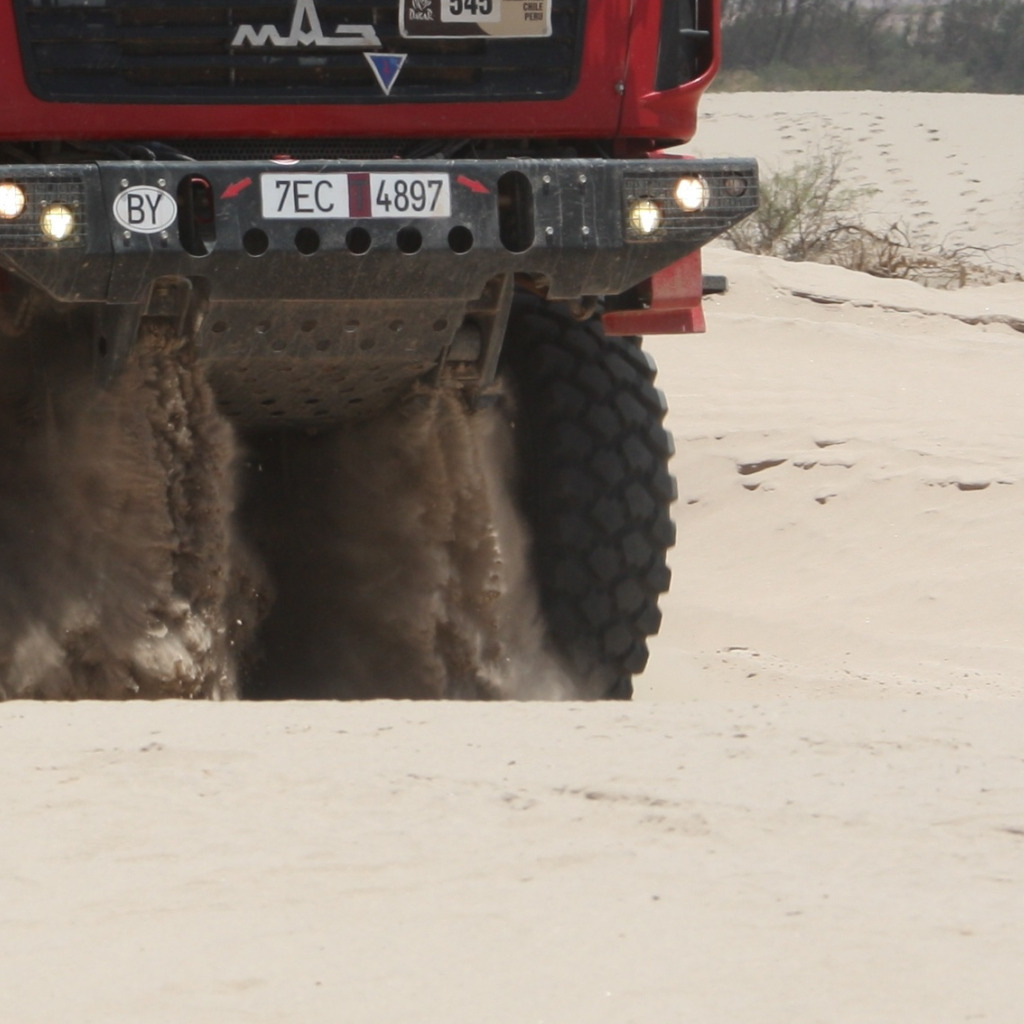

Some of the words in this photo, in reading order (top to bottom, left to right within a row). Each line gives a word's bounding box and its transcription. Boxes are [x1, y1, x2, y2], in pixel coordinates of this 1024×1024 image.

[523, 2, 544, 12] CHILE
[524, 12, 544, 22] PERU
[276, 180, 334, 213] 7EC
[376, 179, 444, 213] 4897
[127, 194, 162, 224] BY
